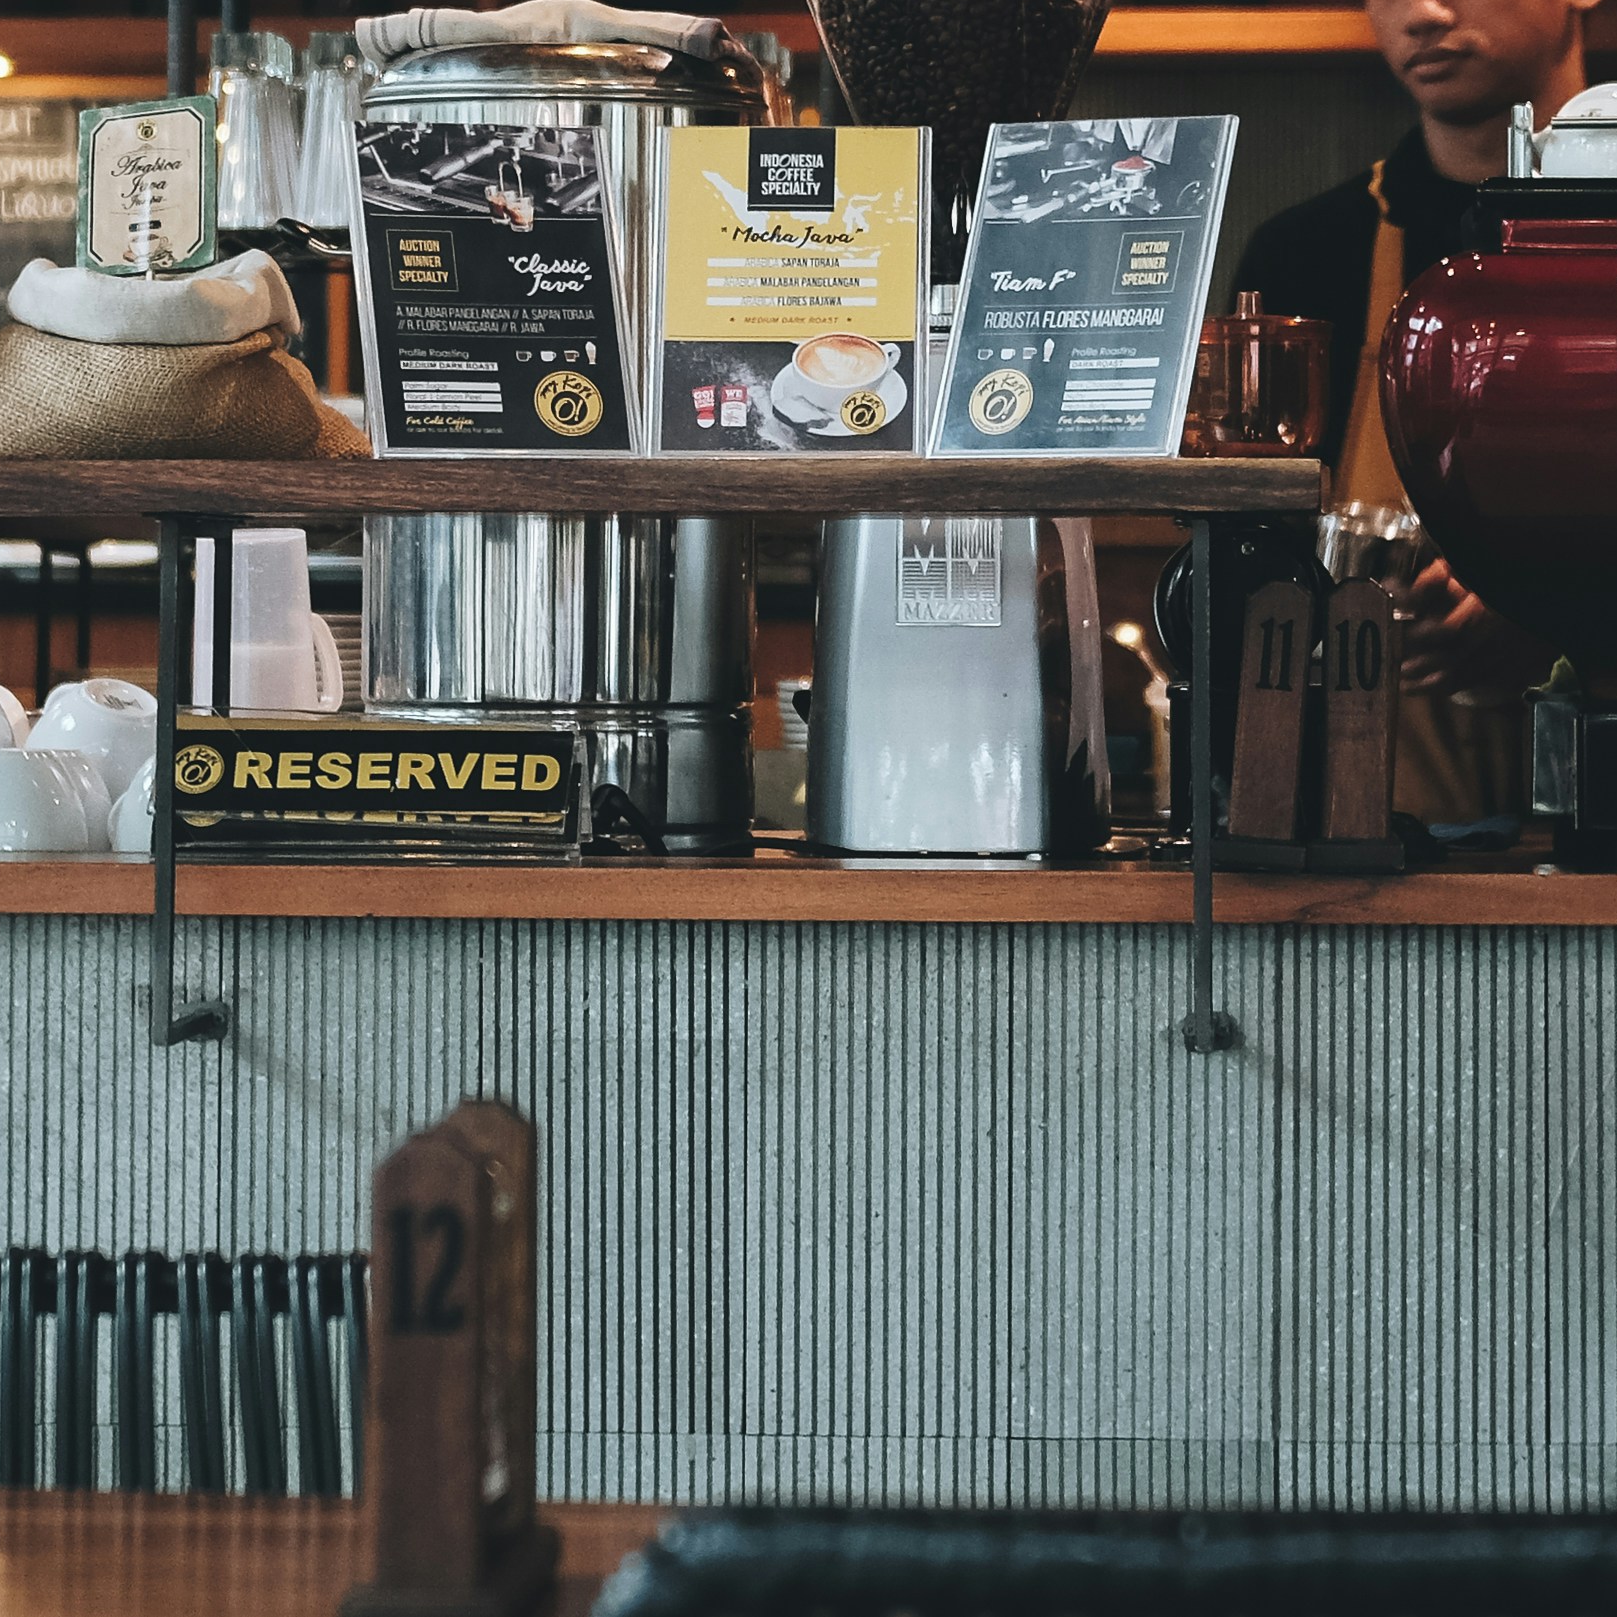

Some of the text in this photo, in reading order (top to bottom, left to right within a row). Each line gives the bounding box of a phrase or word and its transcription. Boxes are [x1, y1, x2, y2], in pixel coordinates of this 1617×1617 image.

[111, 155, 183, 179] Arabica
[760, 154, 824, 168] INDONESIA
[768, 168, 814, 181] COFFEE
[761, 182, 821, 195] SPECIALTY
[399, 239, 440, 252] AUCTION
[1130, 241, 1170, 254] AUCTION
[403, 255, 442, 268] WINNER
[399, 270, 448, 283] SPECIALTY
[1121, 272, 1169, 286] SPECIALTY
[984, 308, 1164, 329] ROBUSTA FLORES MANGGARAI
[1255, 617, 1295, 692] 11
[1335, 619, 1382, 692] 10
[232, 751, 561, 792] RESERVED
[390, 1204, 466, 1333] 12
